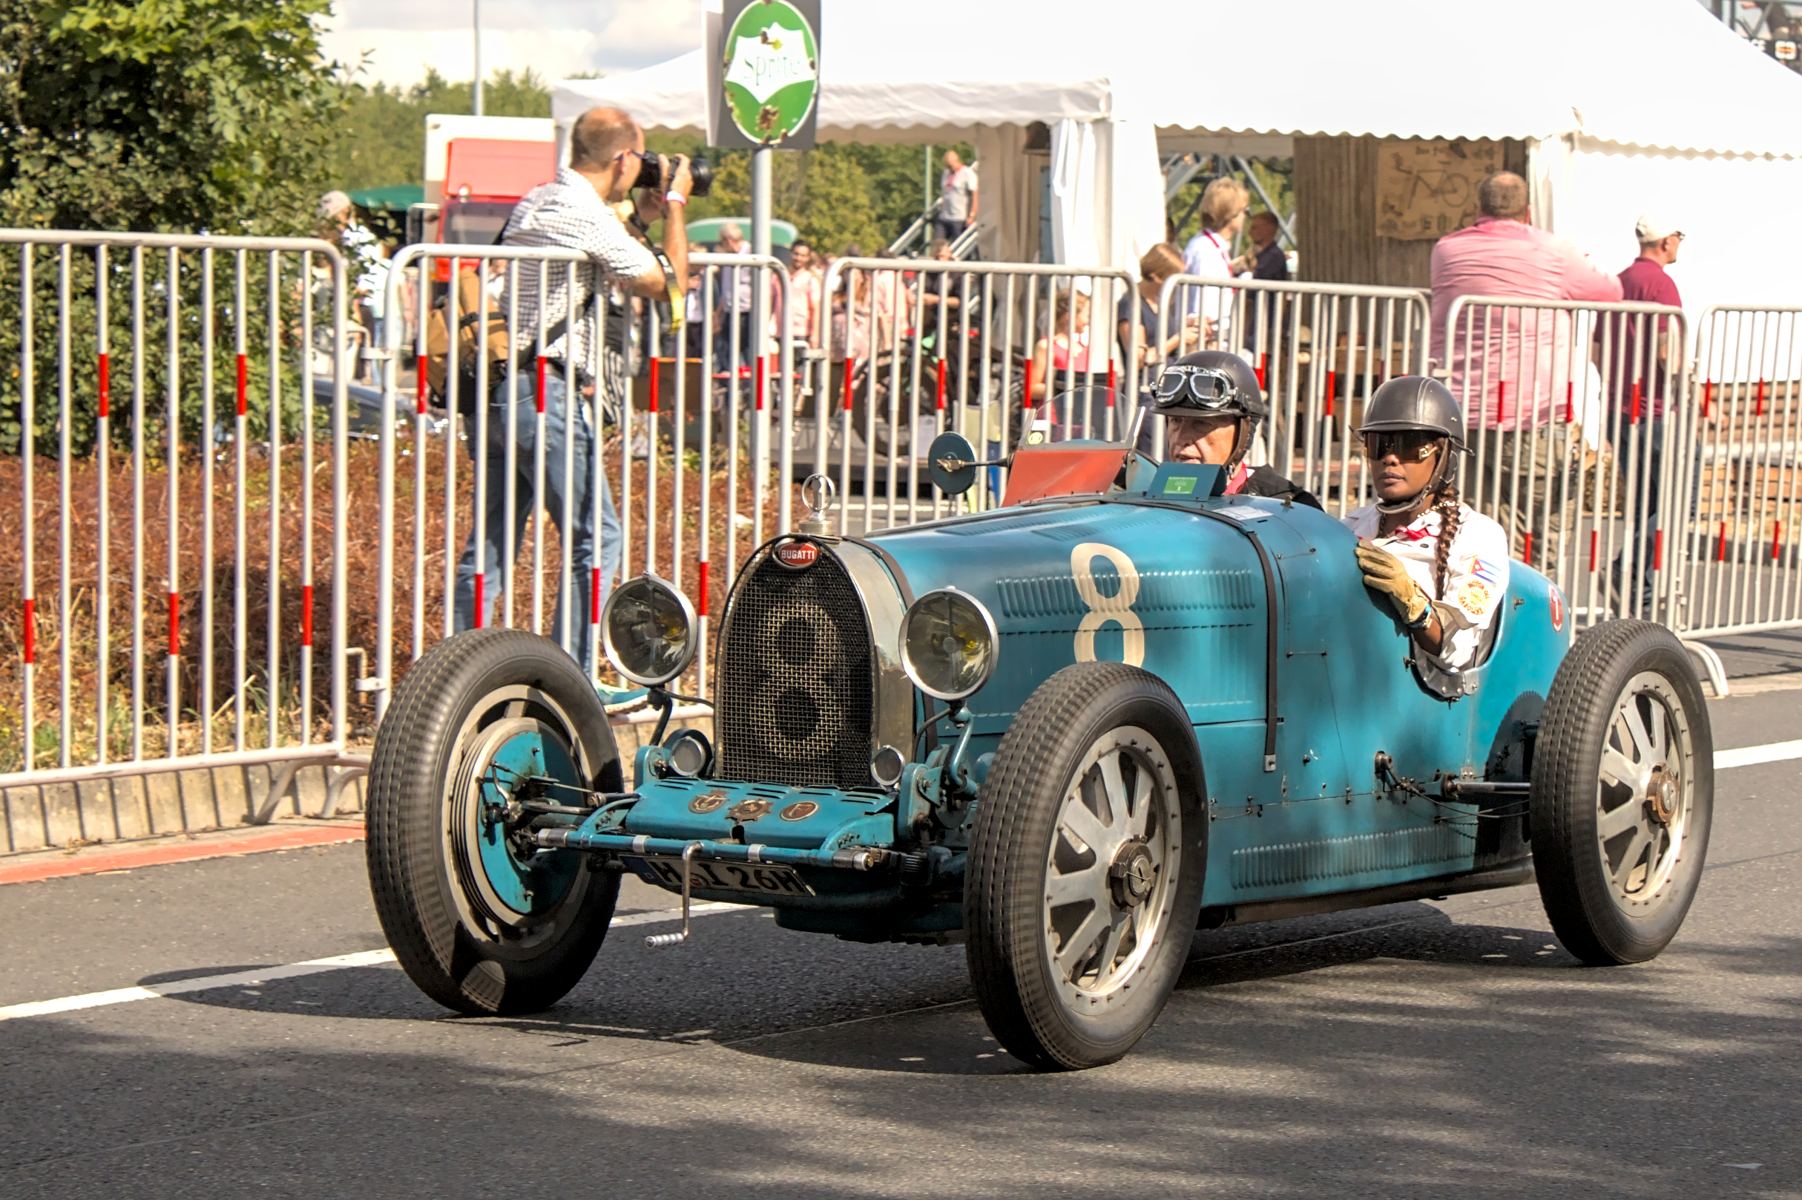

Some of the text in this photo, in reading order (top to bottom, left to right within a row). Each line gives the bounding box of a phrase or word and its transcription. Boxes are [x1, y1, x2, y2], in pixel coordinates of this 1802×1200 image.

[781, 550, 815, 560] BUGATTI
[1070, 542, 1146, 668] 8
[753, 600, 844, 760] 8
